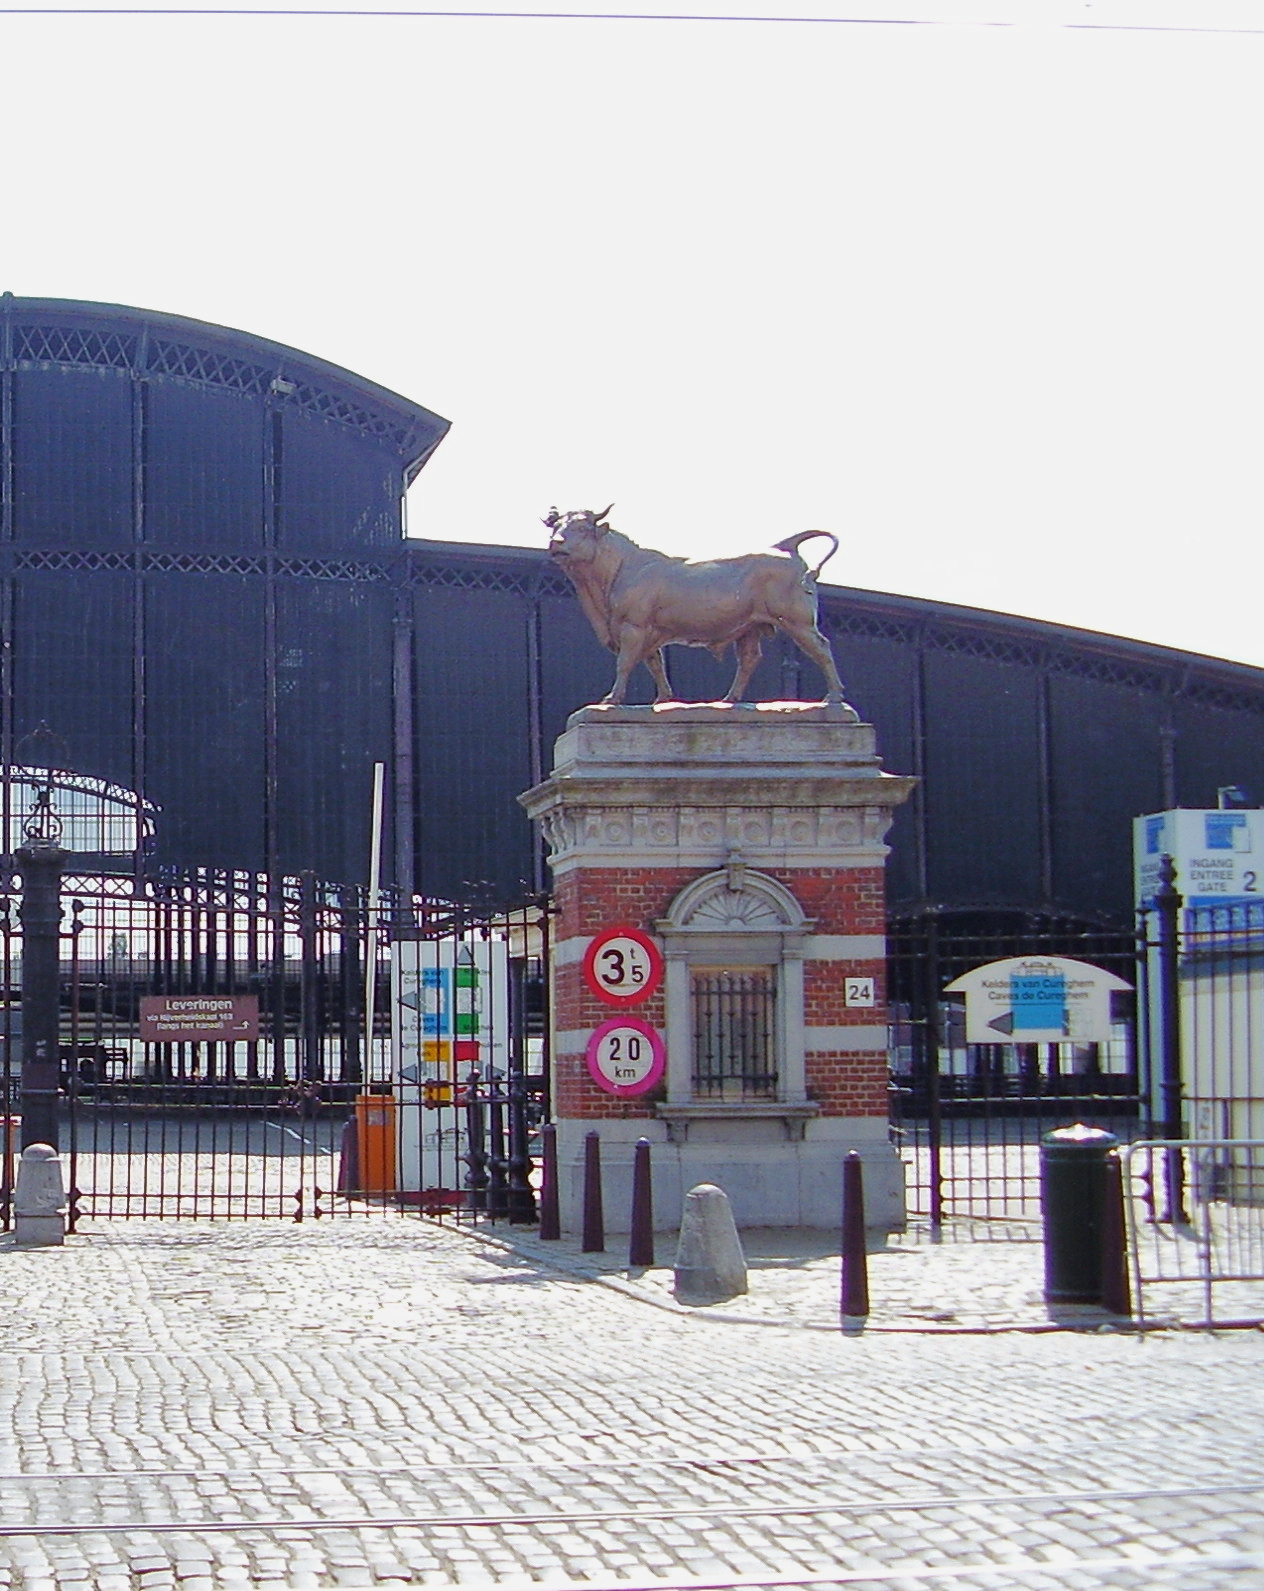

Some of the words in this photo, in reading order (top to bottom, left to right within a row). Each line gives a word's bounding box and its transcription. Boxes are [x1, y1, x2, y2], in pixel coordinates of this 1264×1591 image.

[1190, 870, 1234, 880] ENTREE
[1198, 882, 1227, 892] GATE
[1243, 871, 1257, 892] 2
[630, 948, 636, 959] t
[601, 949, 625, 985] 3
[631, 965, 644, 983] 5
[981, 979, 1019, 988] Kelders
[1044, 979, 1095, 990] Cureghem
[849, 984, 870, 1000] 24
[988, 991, 1019, 1000] Caves
[1021, 991, 1035, 1000] de
[1037, 991, 1088, 1001] Cureghem
[166, 999, 233, 1011] Leveringen
[609, 1037, 641, 1061] 20
[614, 1066, 636, 1078] km
